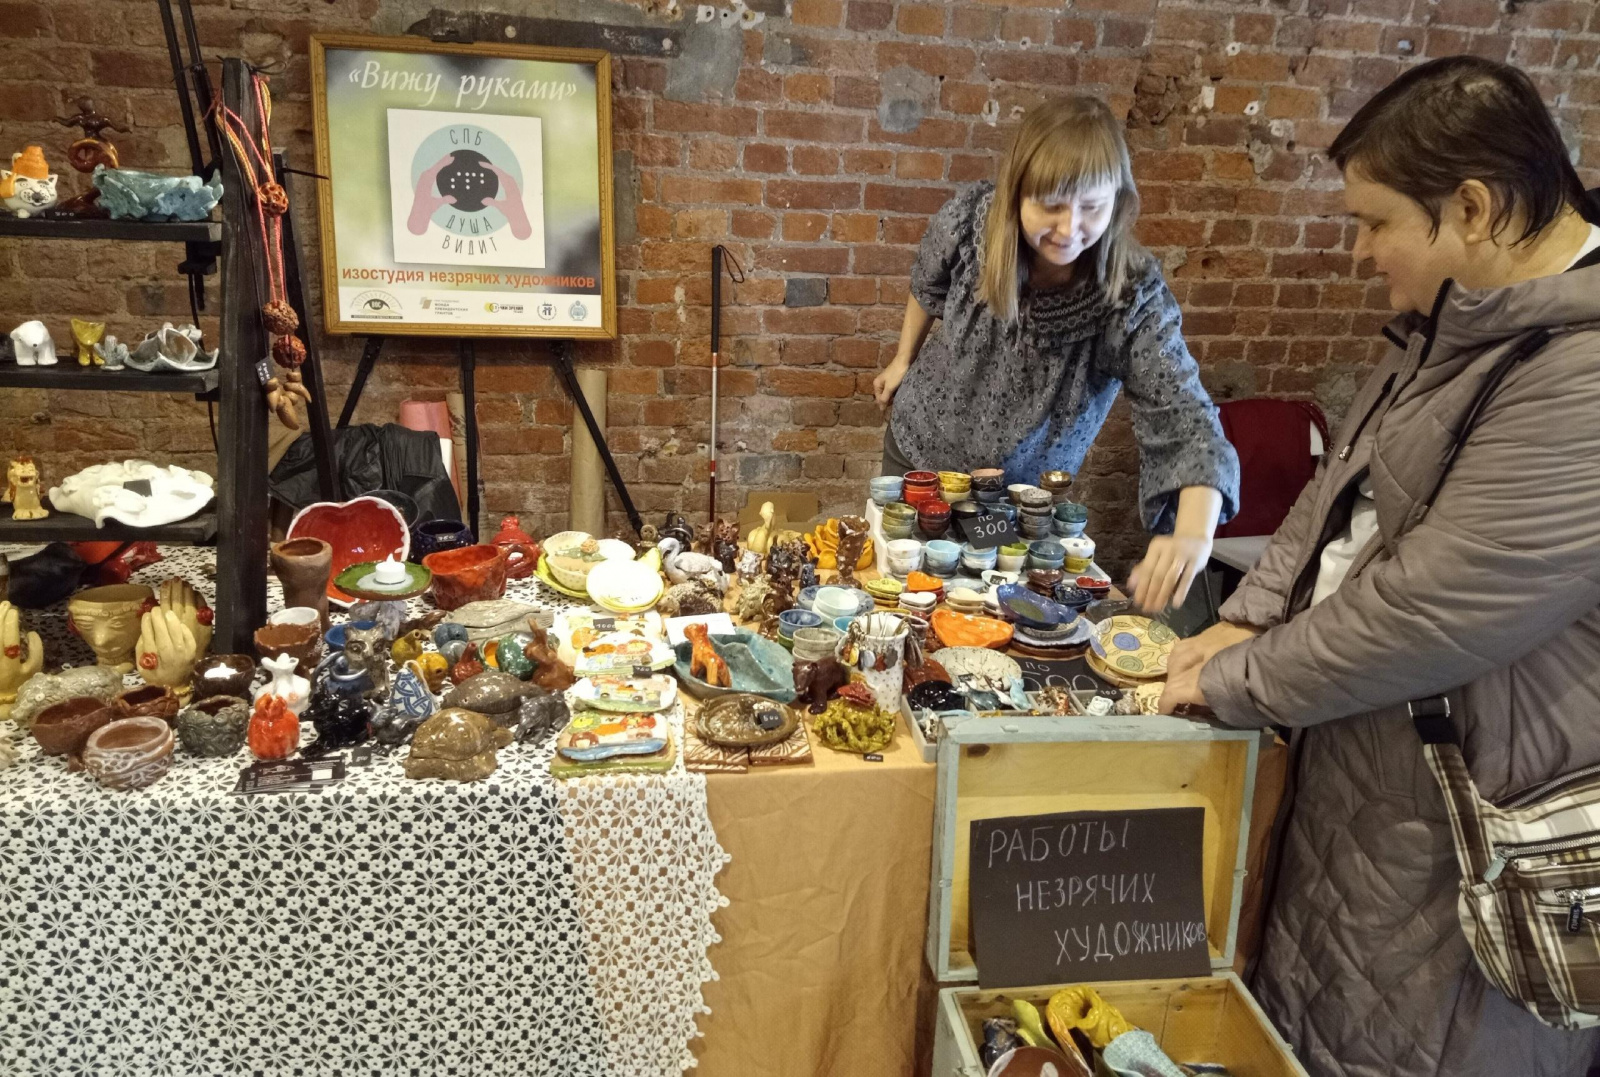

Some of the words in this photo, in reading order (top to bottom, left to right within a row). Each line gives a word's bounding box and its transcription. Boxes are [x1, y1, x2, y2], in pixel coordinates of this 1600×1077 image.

[349, 60, 442, 107] «Вижу
[455, 73, 577, 110] руками»
[449, 127, 483, 146] СПБ
[445, 214, 493, 234] ДУША
[441, 234, 498, 255] ВИДИТ
[342, 267, 424, 284] изостудия
[429, 271, 500, 287] незрячих
[505, 273, 596, 289] художников
[973, 519, 1008, 539] 300
[988, 818, 1130, 868] РАБОТЫ
[1016, 872, 1156, 912] НЕЗРЯЧИХ
[1054, 920, 1206, 966] ХУДОЖНИКОВ
